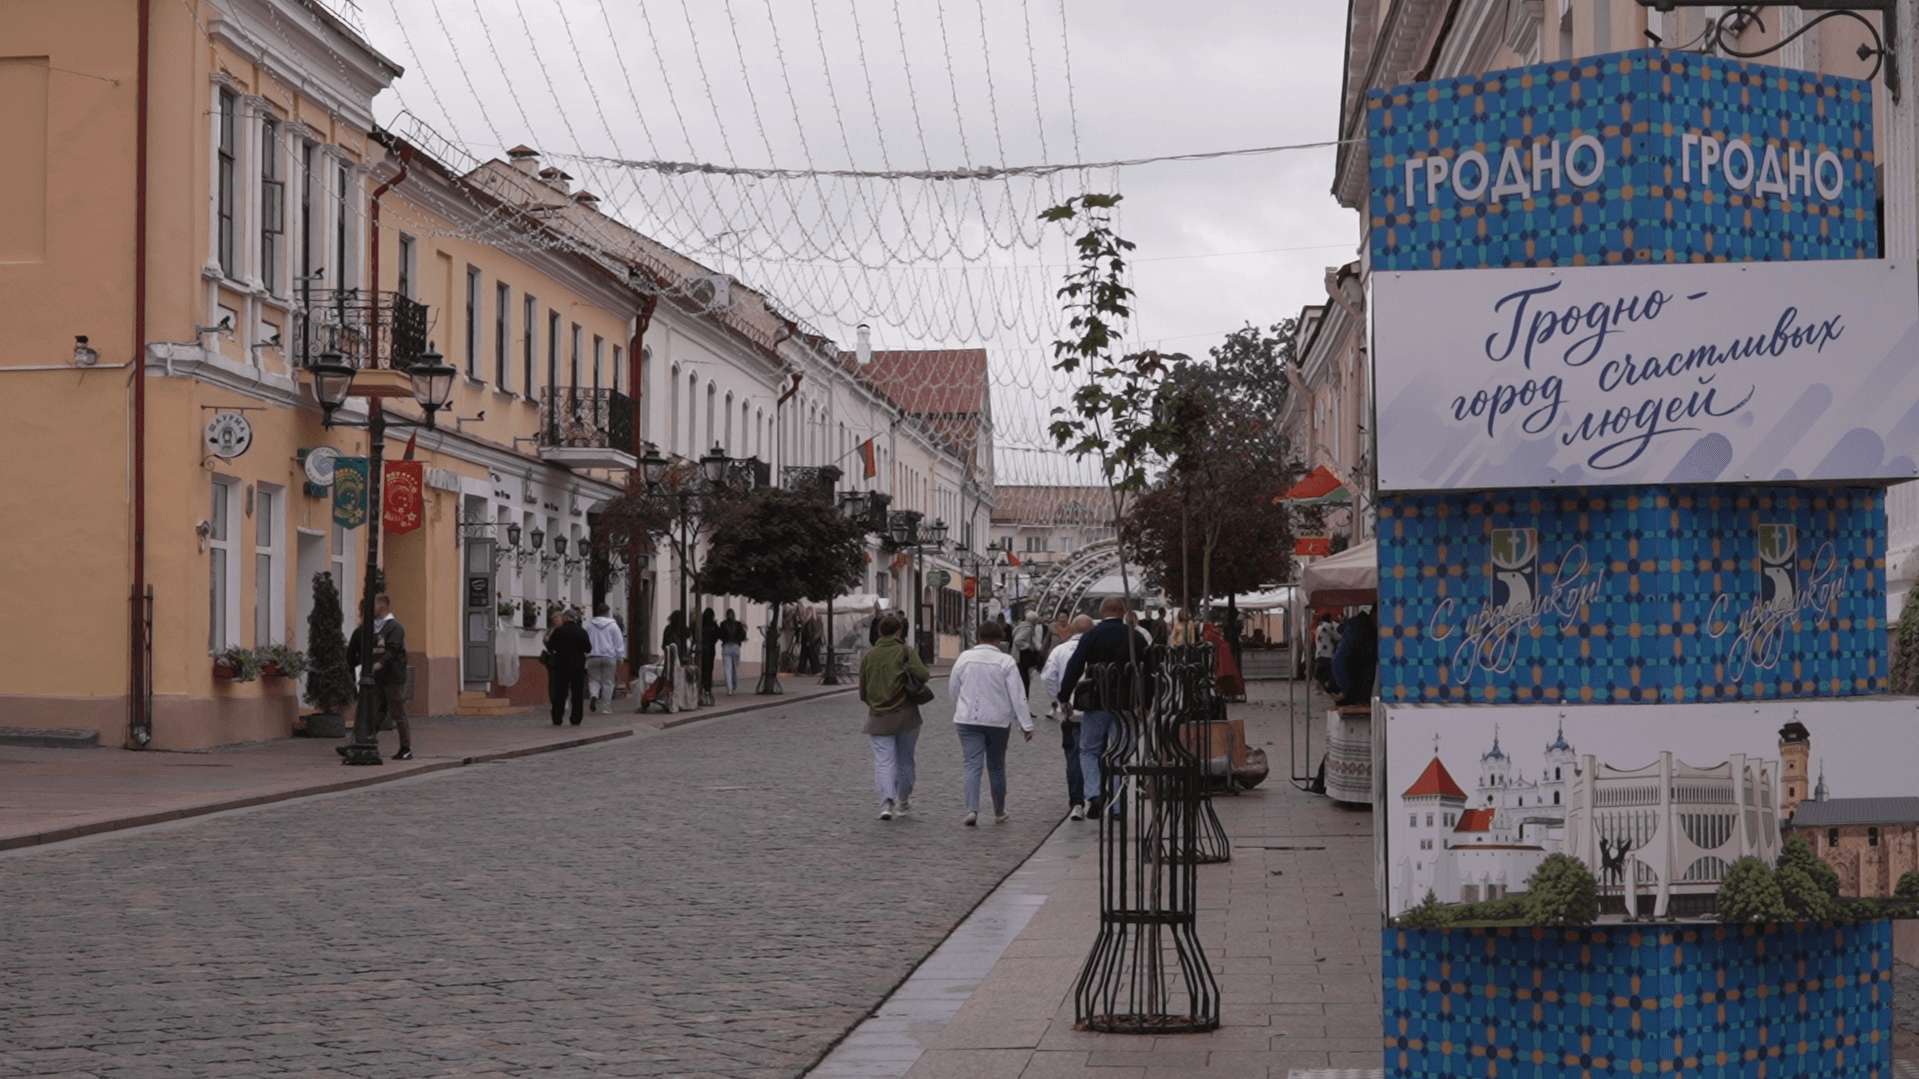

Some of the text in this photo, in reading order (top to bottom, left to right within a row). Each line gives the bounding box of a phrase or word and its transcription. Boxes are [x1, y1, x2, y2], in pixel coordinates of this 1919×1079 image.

[1404, 134, 1605, 207] ГРОДНО
[1681, 132, 1844, 201] ГРОДНО
[1484, 279, 1674, 370] Гродно
[1450, 306, 1846, 438] город счастливых
[208, 413, 246, 433] ШАУРМА
[1561, 372, 1756, 470] людей
